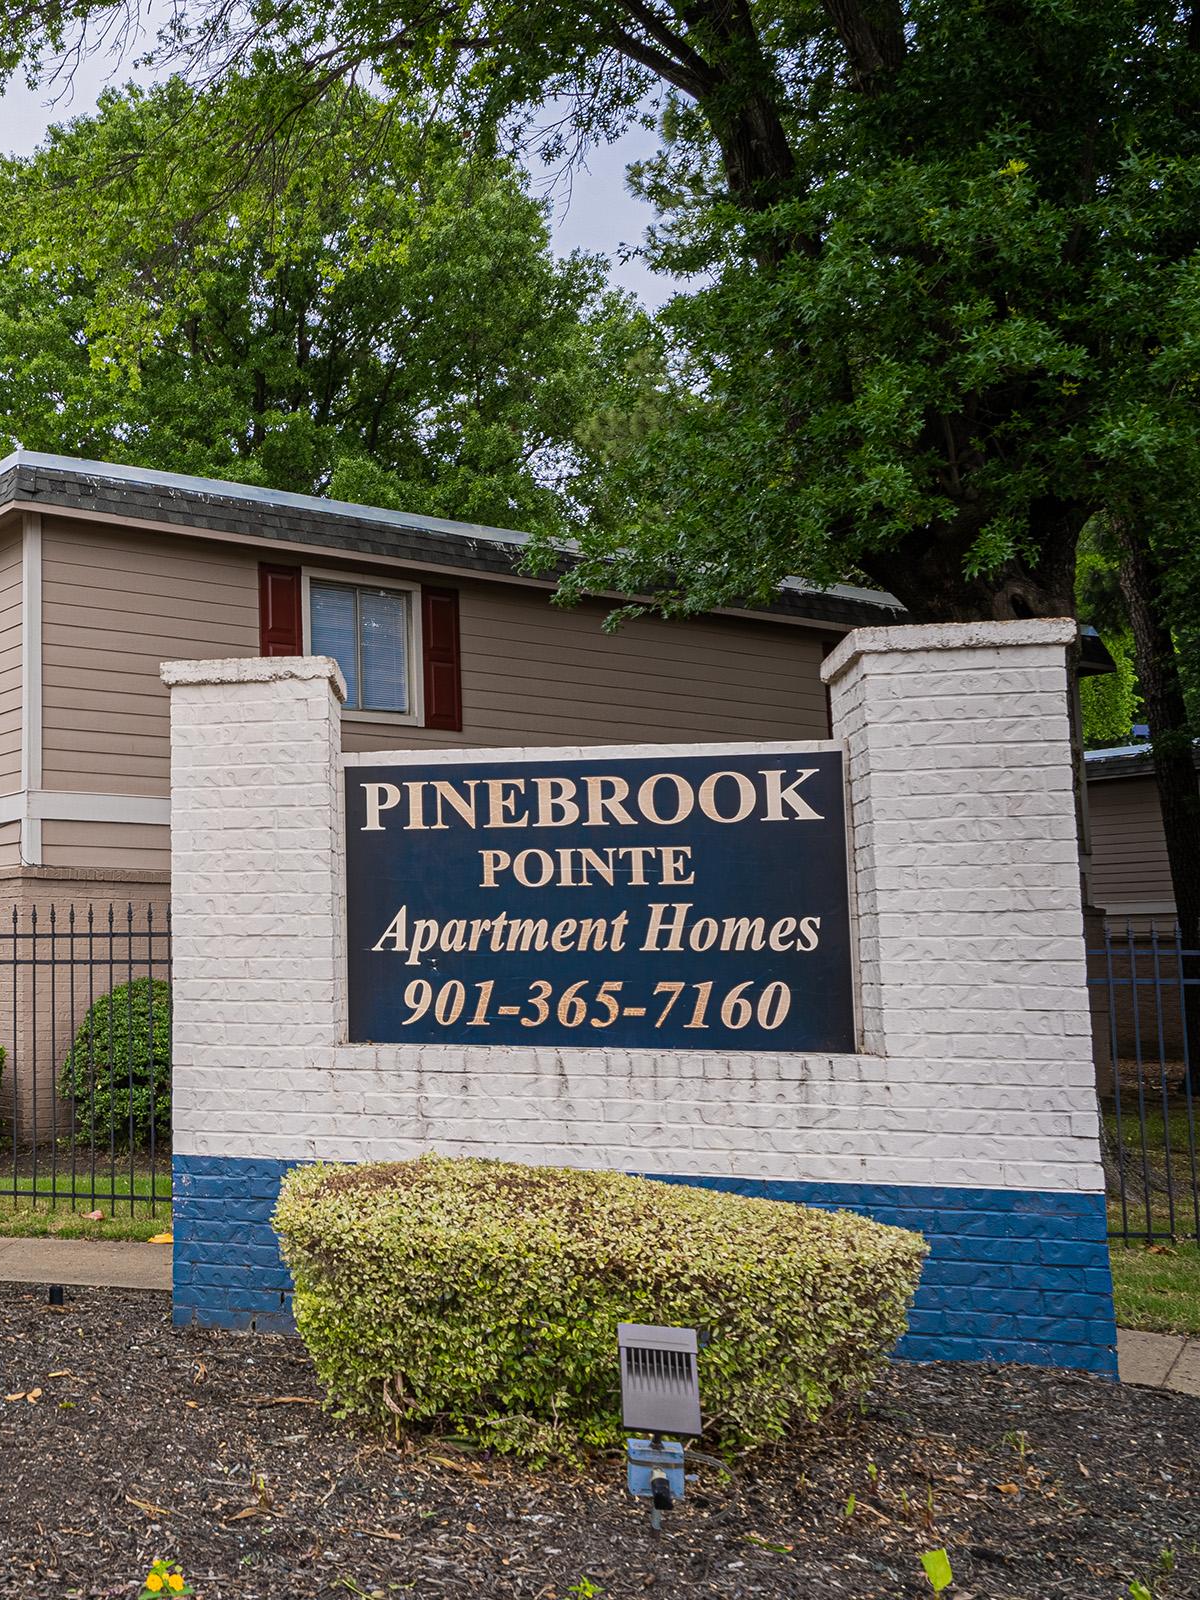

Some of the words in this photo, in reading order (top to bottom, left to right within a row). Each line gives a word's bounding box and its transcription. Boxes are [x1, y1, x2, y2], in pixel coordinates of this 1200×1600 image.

[360, 767, 825, 831] PINEBROOK
[478, 846, 695, 888] POINTE
[371, 904, 629, 966] Apartment
[638, 902, 821, 953] Homes
[401, 978, 791, 1030] 901-365-7160
